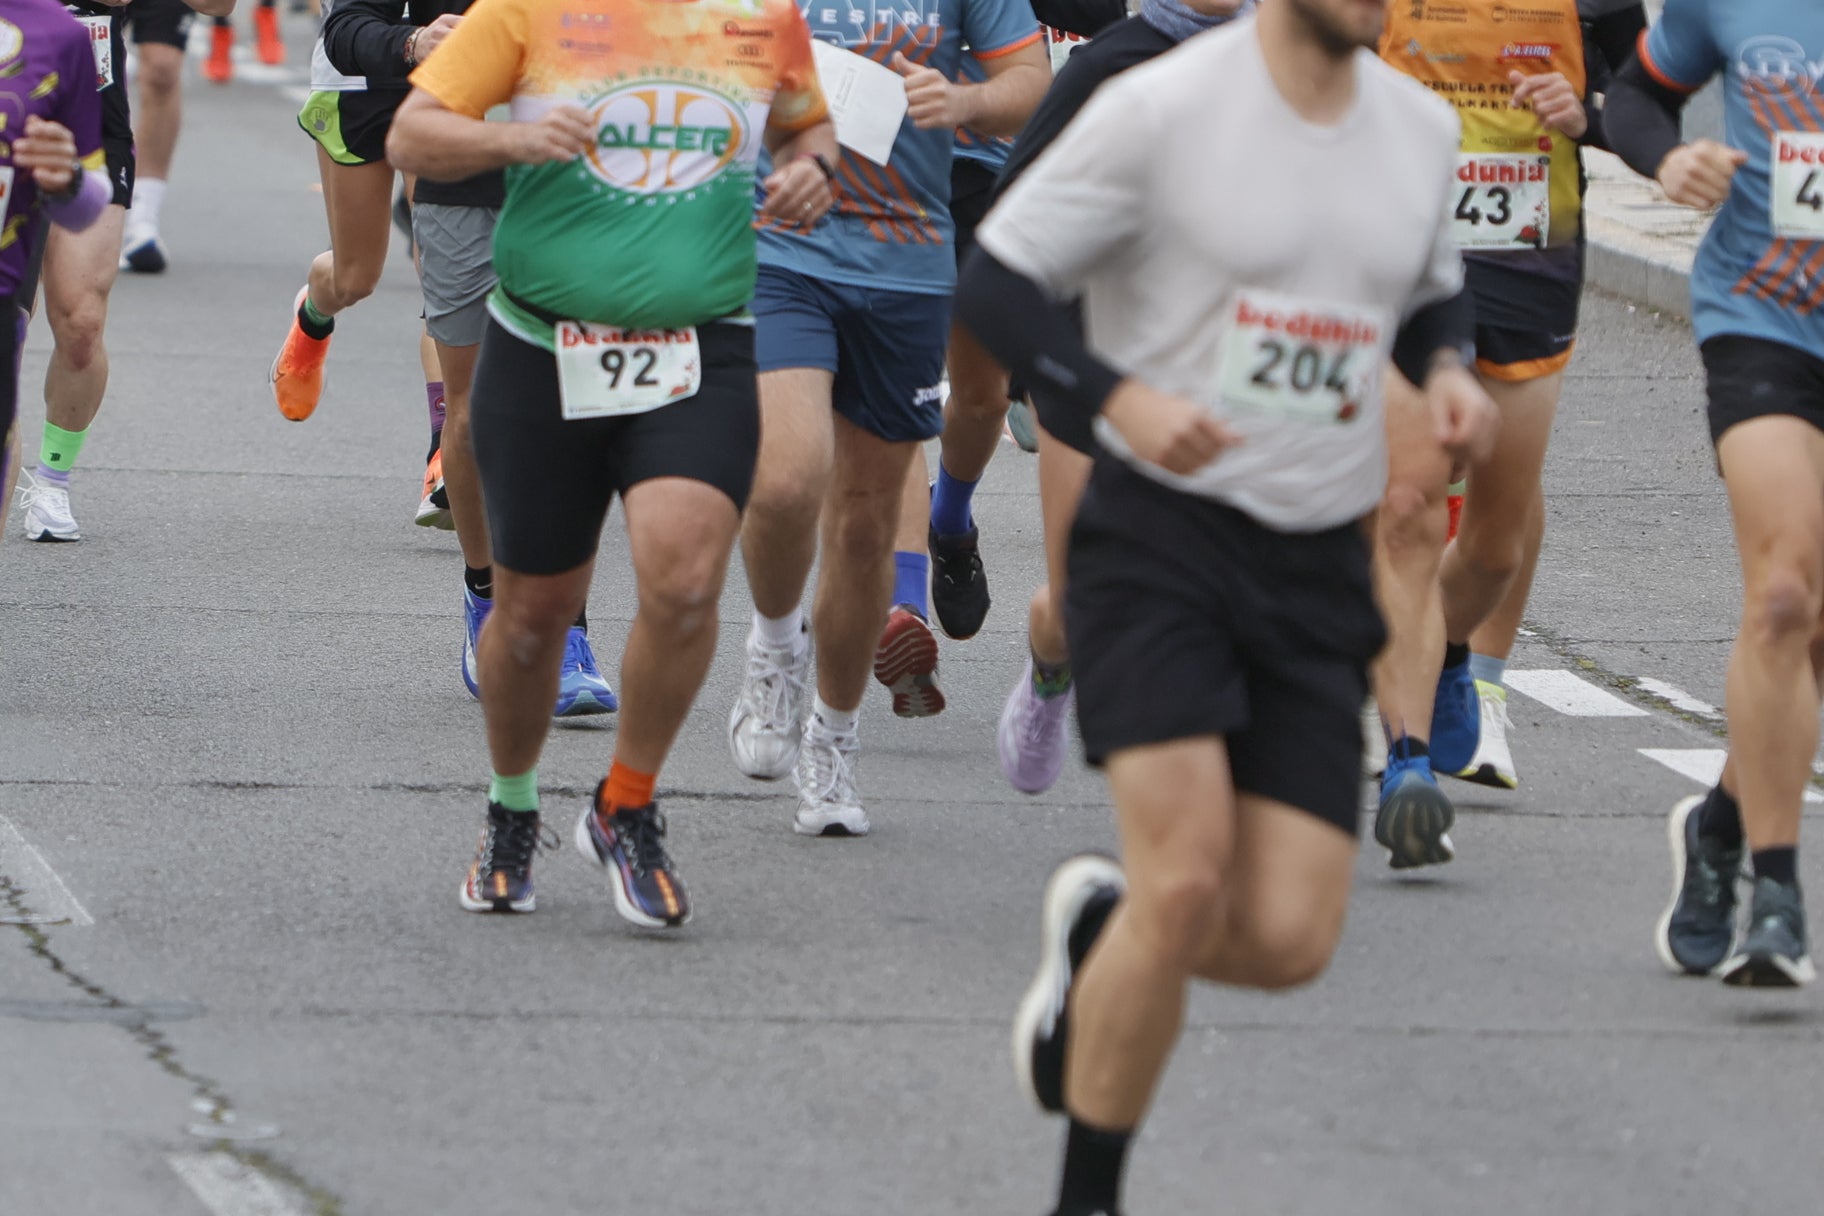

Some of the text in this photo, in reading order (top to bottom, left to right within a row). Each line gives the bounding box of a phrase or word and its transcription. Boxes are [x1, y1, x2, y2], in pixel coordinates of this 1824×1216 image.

[1455, 185, 1512, 226] 43
[600, 347, 660, 390] 92
[1251, 339, 1350, 394] 204
